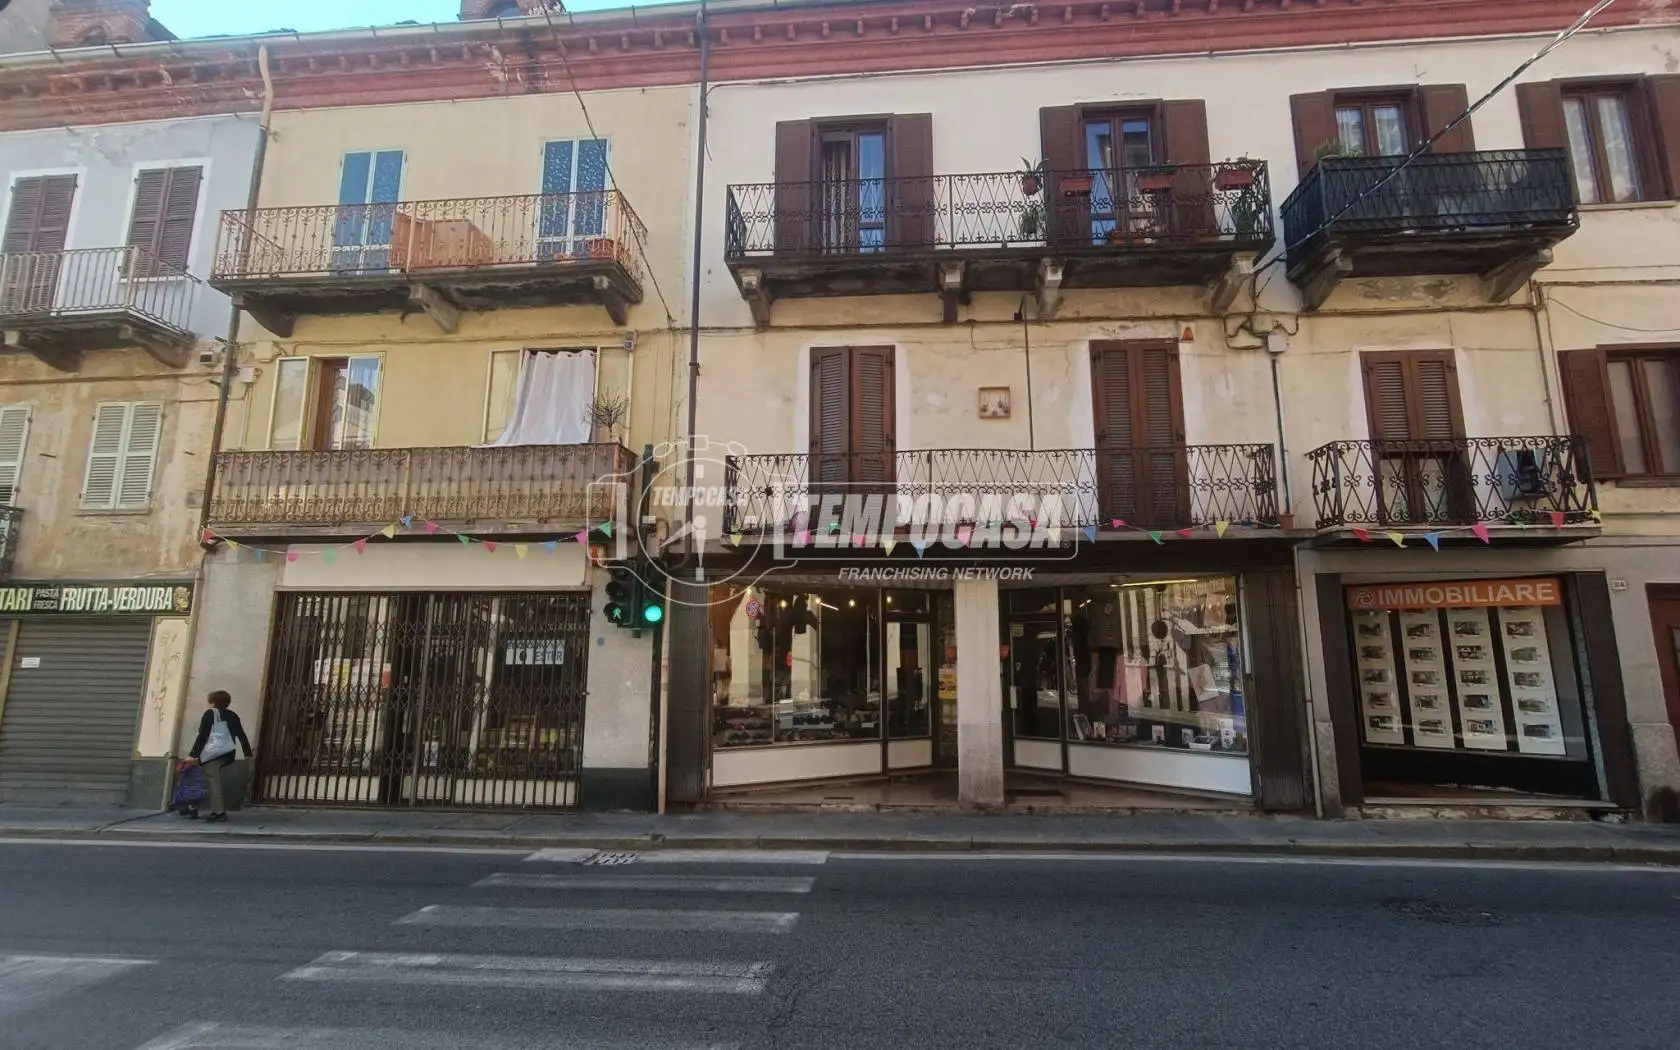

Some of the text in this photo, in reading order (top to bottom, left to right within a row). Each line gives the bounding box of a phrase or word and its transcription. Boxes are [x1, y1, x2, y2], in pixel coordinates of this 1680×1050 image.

[0, 588, 34, 610] TARI
[35, 588, 59, 598] PASTA
[59, 587, 173, 611] FRUTTA-VERDURA
[1378, 583, 1555, 605] IMMOBILIARE
[33, 600, 58, 609] FRESCA
